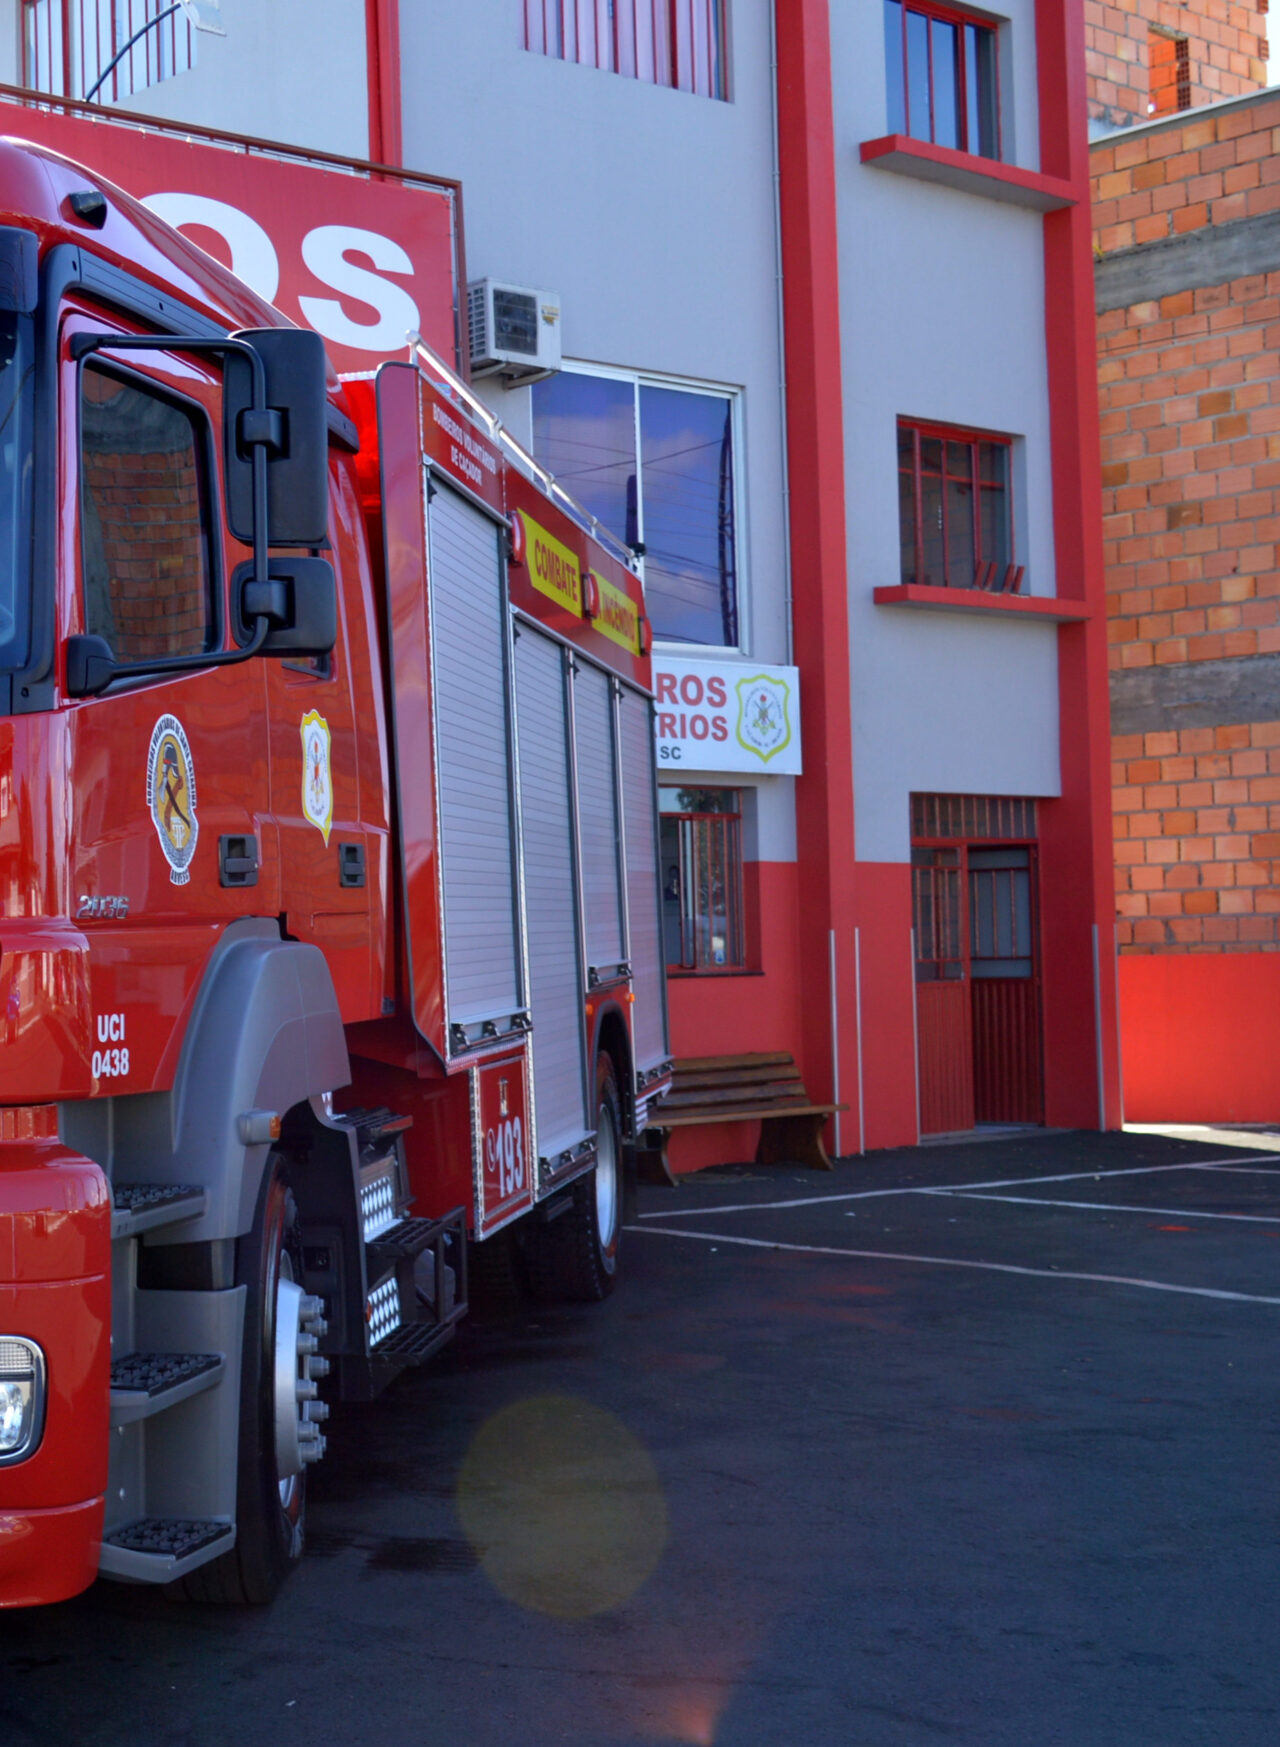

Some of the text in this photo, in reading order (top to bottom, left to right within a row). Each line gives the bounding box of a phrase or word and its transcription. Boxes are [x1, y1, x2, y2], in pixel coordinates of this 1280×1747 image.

[433, 403, 463, 446] BOMBEIROS
[451, 445, 459, 467] DE
[534, 539, 578, 602] COMBATE
[654, 711, 729, 742] RIOS
[660, 746, 681, 760] SC
[97, 1014, 126, 1042] UCI
[92, 1048, 130, 1079] 0438
[496, 1116, 524, 1199] 193
